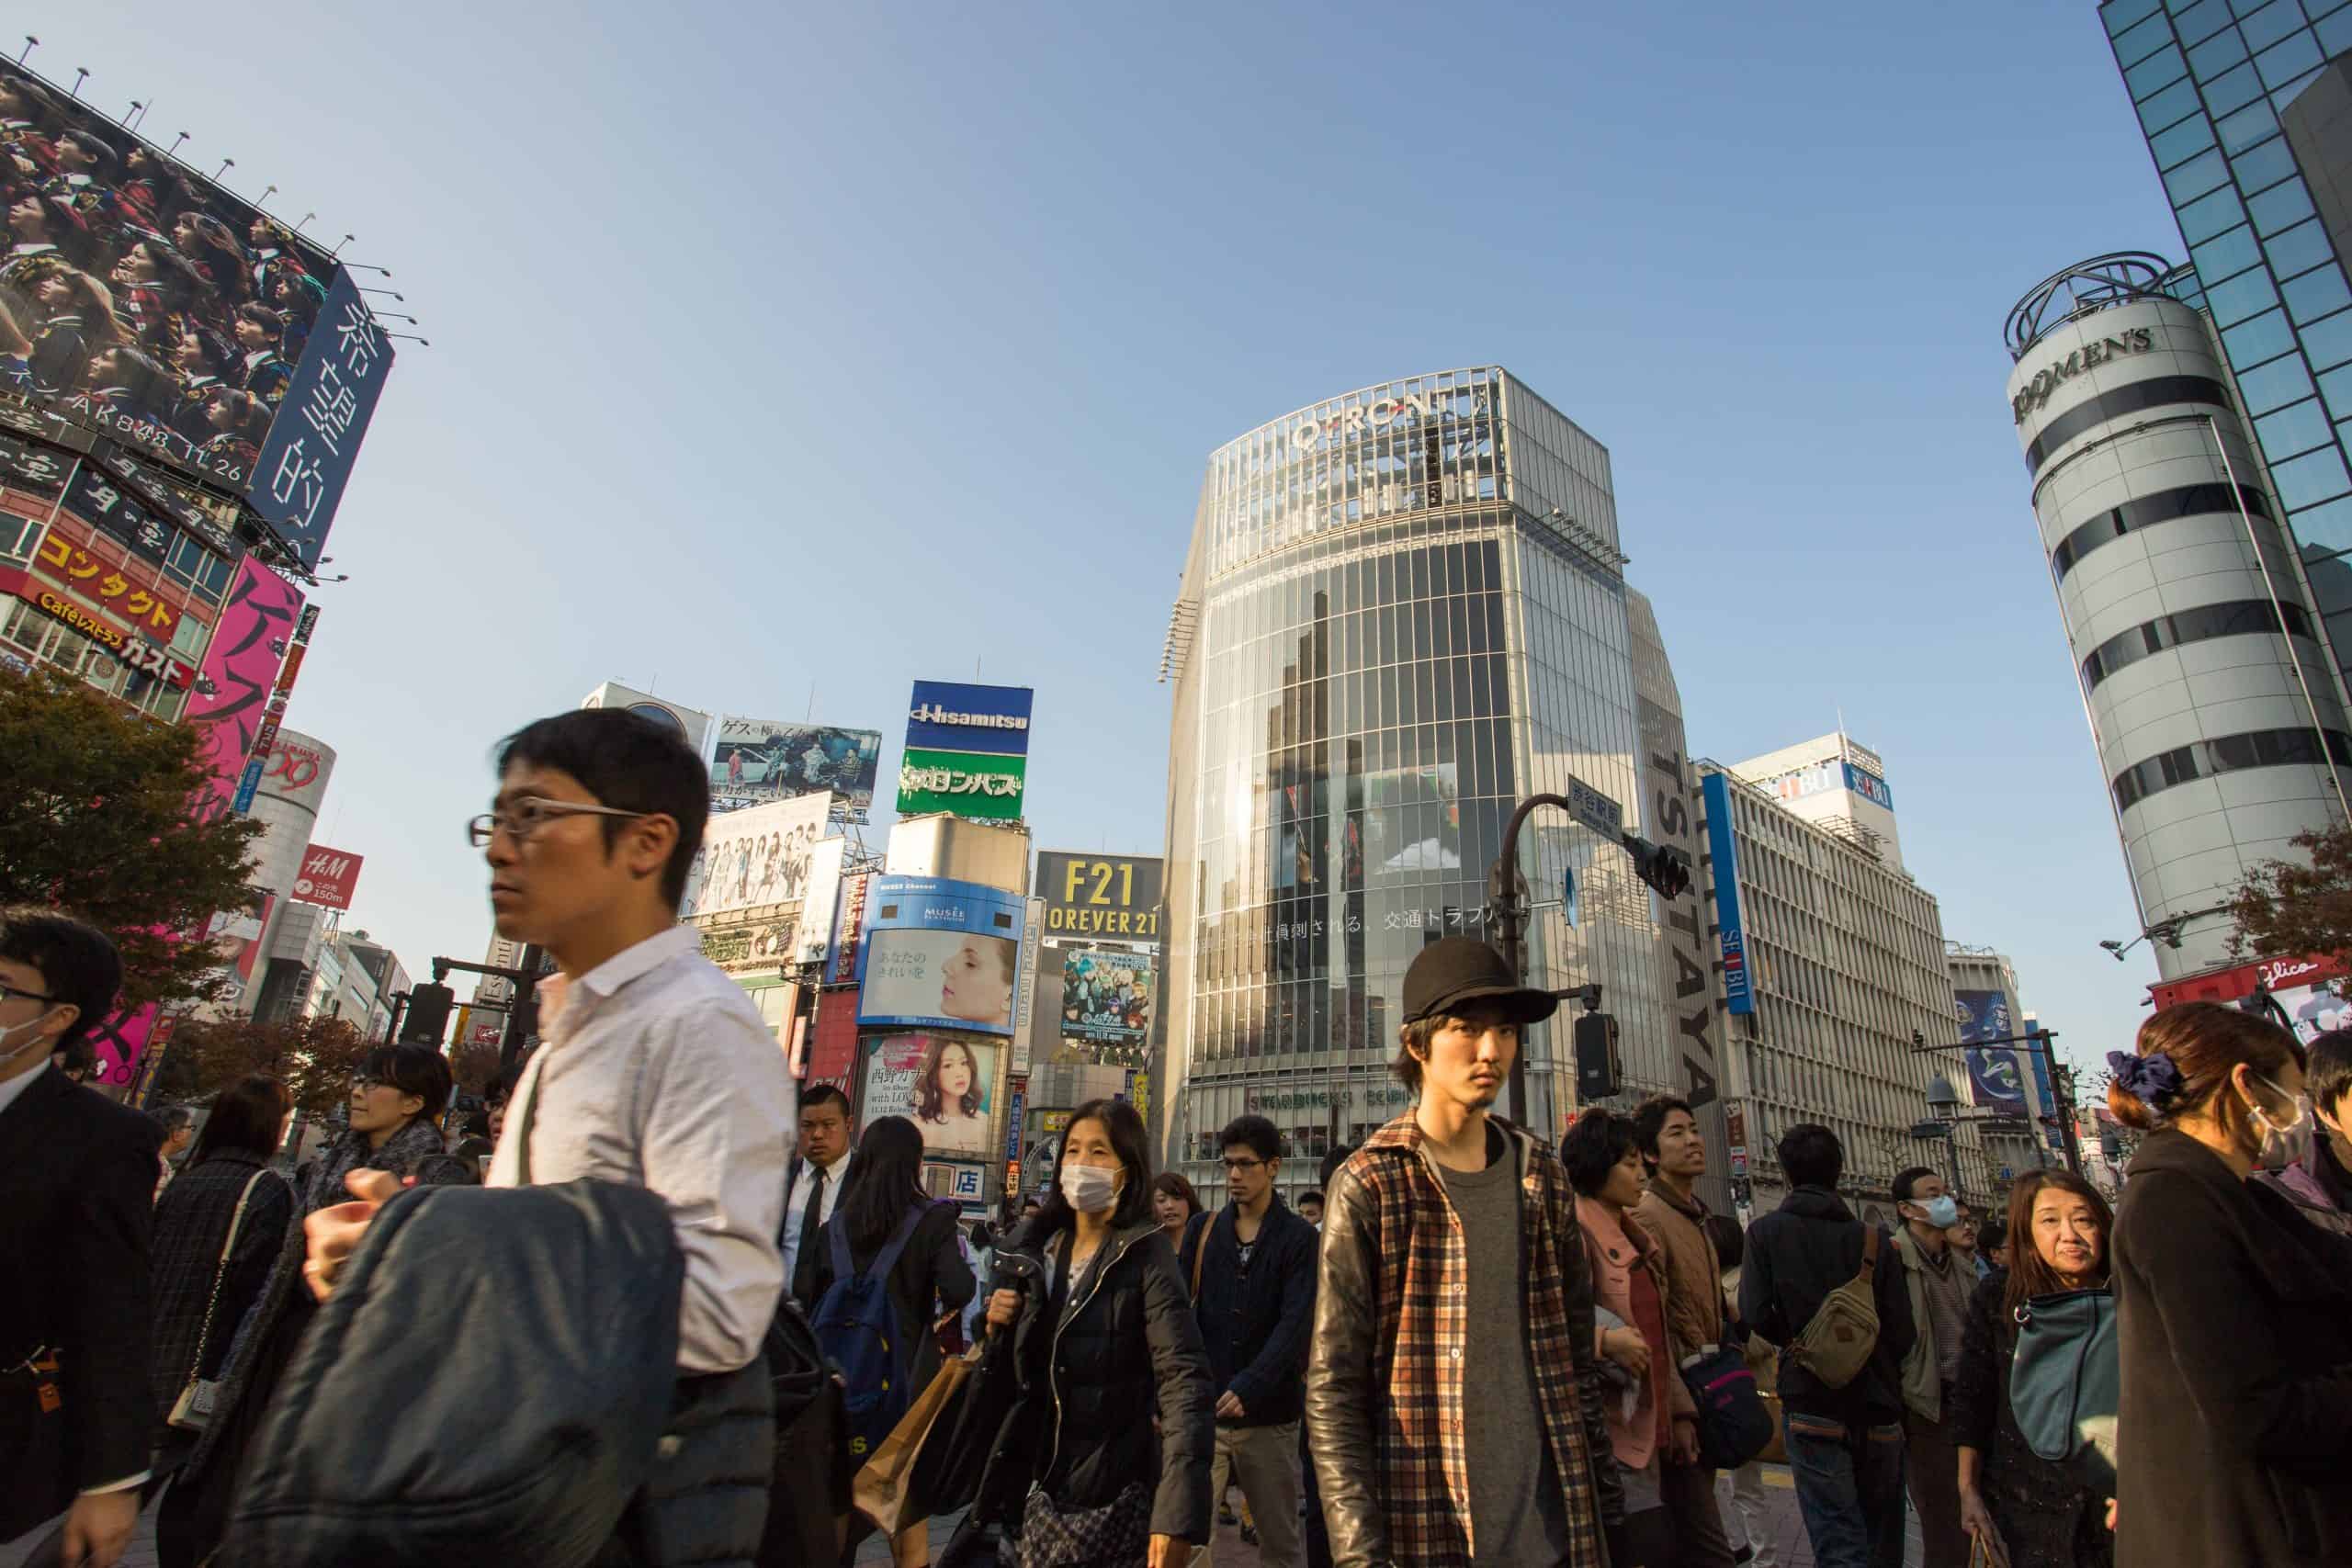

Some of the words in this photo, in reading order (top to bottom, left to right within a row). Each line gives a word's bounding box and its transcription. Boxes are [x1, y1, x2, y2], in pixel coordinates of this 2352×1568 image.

[71, 395, 169, 448] AKB48
[39, 534, 173, 627] コンタクト
[119, 637, 183, 681] ガスト
[910, 702, 1029, 730] Hisamitsu
[306, 852, 351, 880] H&M
[313, 888, 344, 904] 150m
[1065, 860, 1133, 907] F21
[1049, 908, 1131, 933] OREVER
[1135, 912, 1158, 935] 21
[1722, 928, 1746, 1000] SEIBU
[871, 1066, 927, 1084] 西野カナ
[956, 1169, 978, 1193] 店
